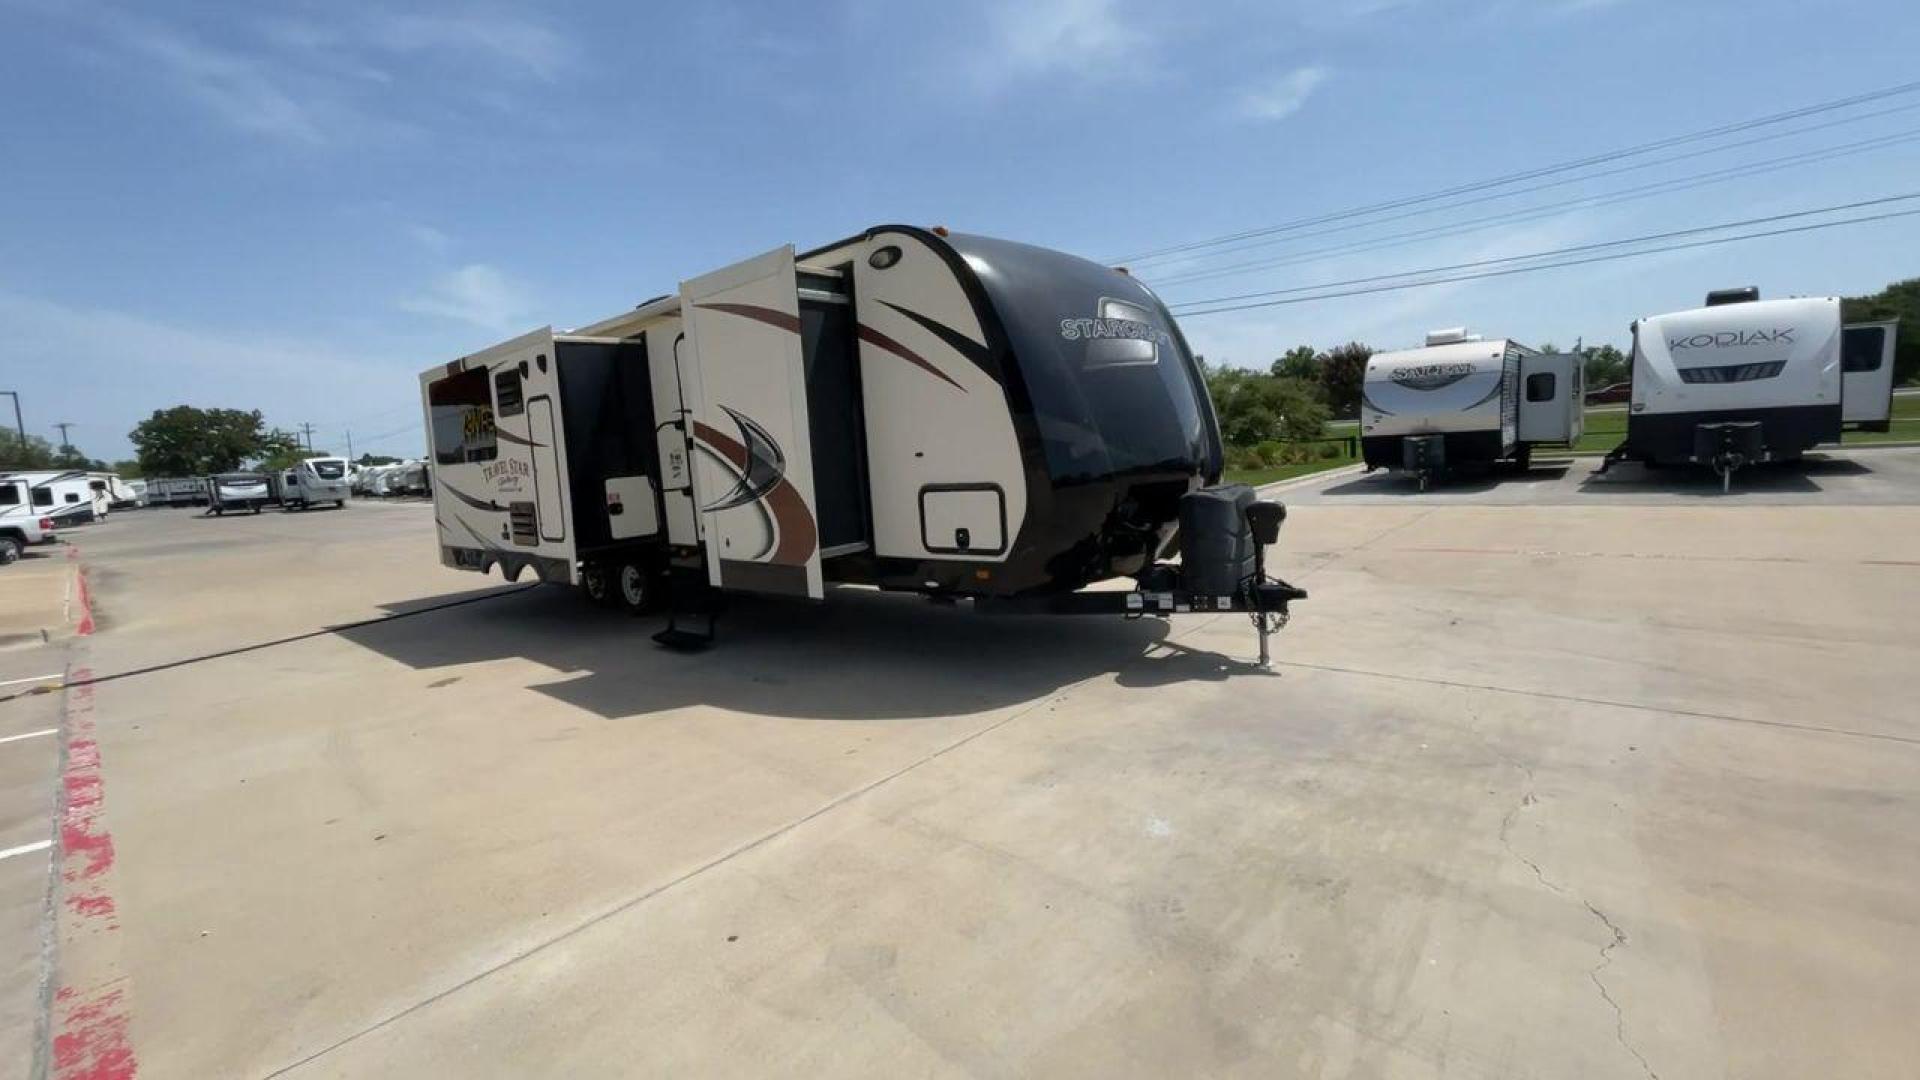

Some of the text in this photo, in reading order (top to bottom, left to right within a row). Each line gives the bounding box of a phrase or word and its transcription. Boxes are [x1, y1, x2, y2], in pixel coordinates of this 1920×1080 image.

[1060, 318, 1168, 341] STARC
[1670, 328, 1795, 351] KODIAK
[509, 457, 530, 477] STAR
